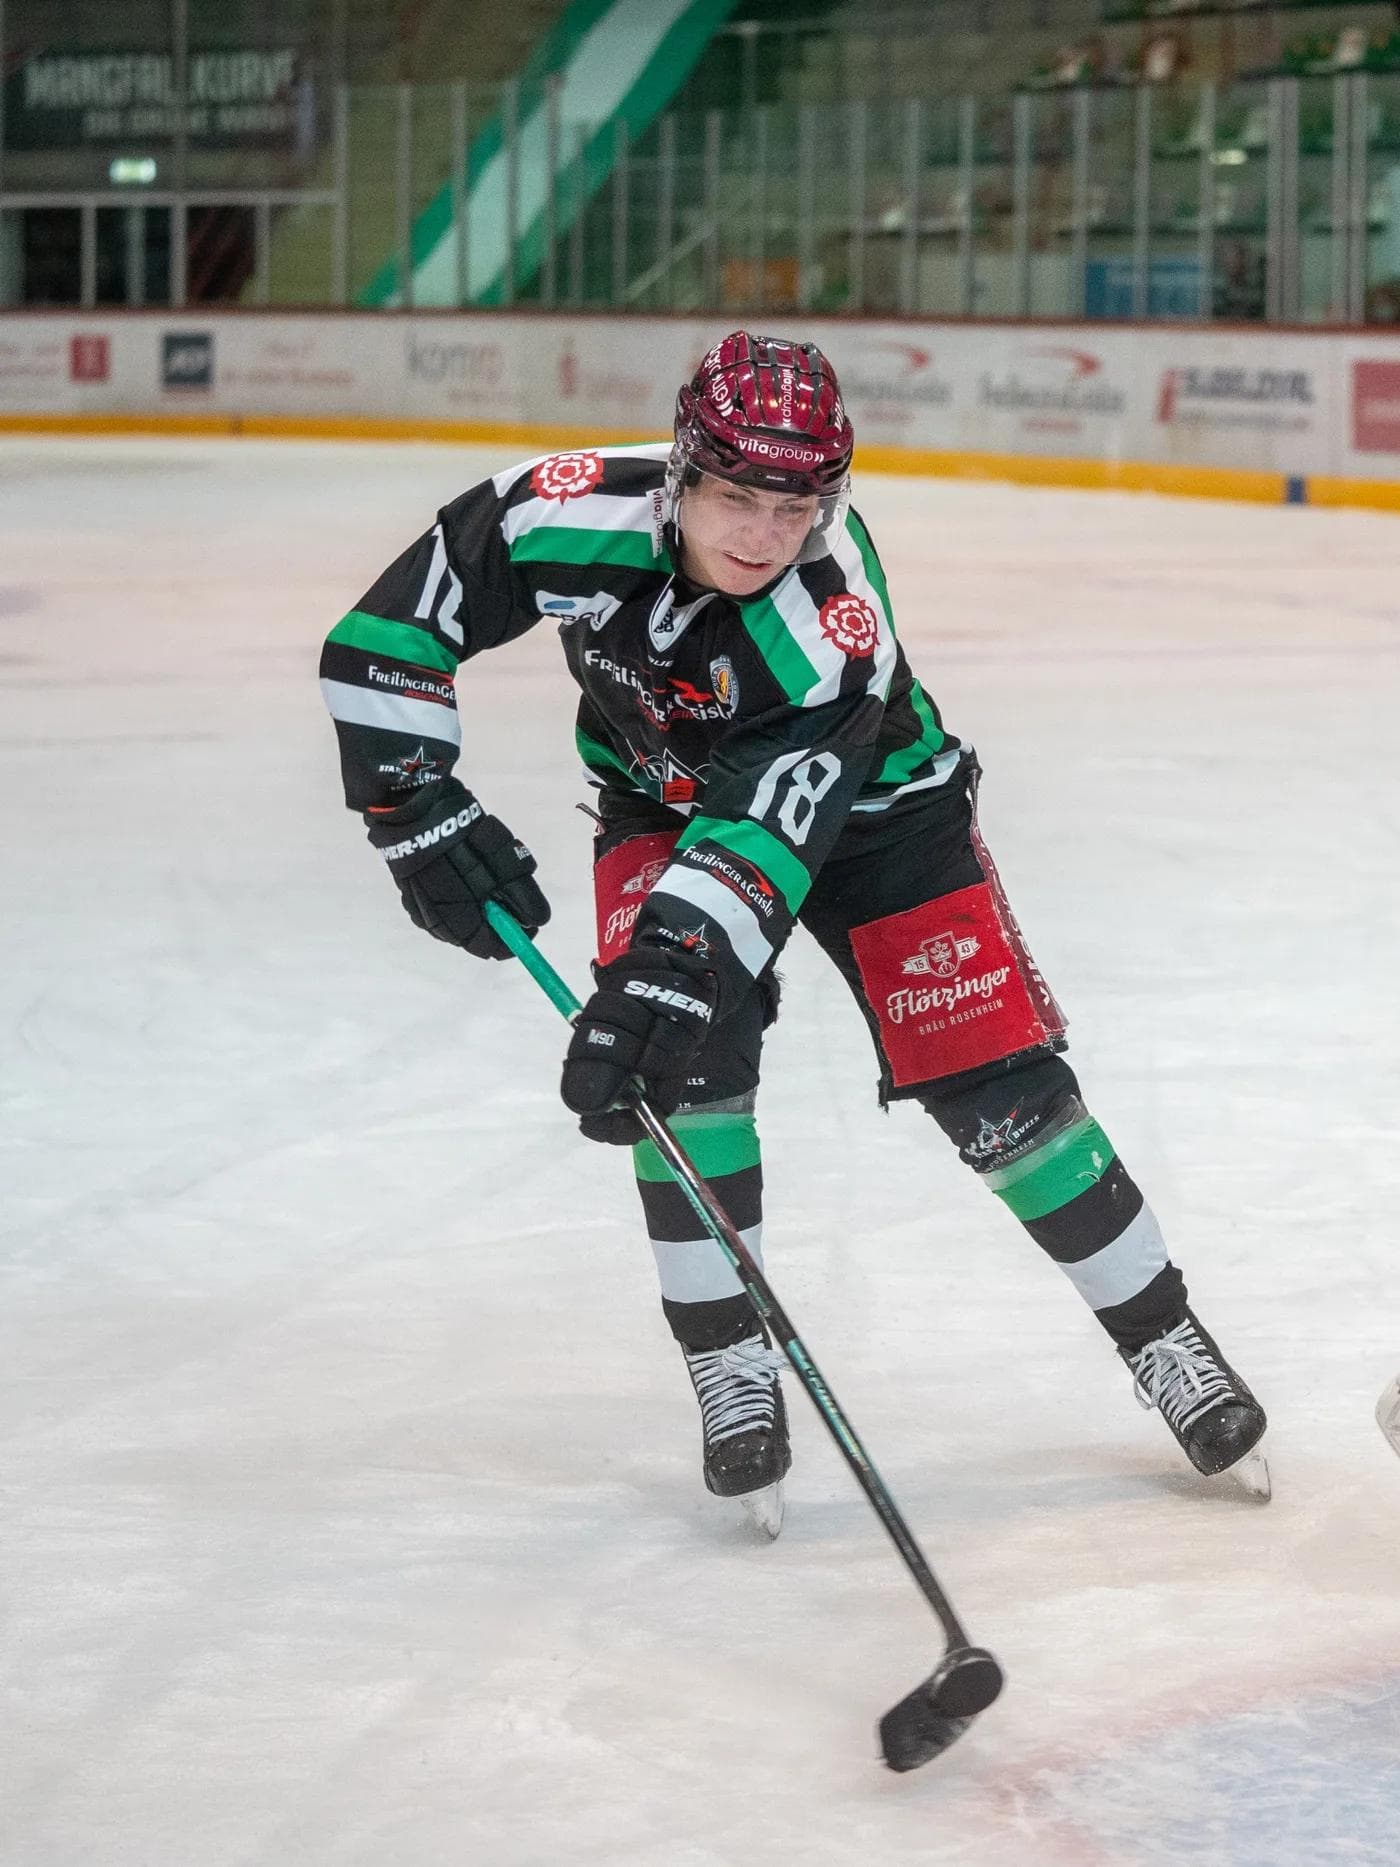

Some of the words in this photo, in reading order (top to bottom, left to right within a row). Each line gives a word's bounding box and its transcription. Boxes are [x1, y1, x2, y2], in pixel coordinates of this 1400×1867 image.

[738, 438, 815, 463] vitagroup
[747, 747, 842, 846] 18
[961, 943, 972, 954] 43
[914, 960, 925, 970] 15
[887, 964, 1011, 1025] Flötzinger
[949, 998, 1004, 1026] ROSENHEIM
